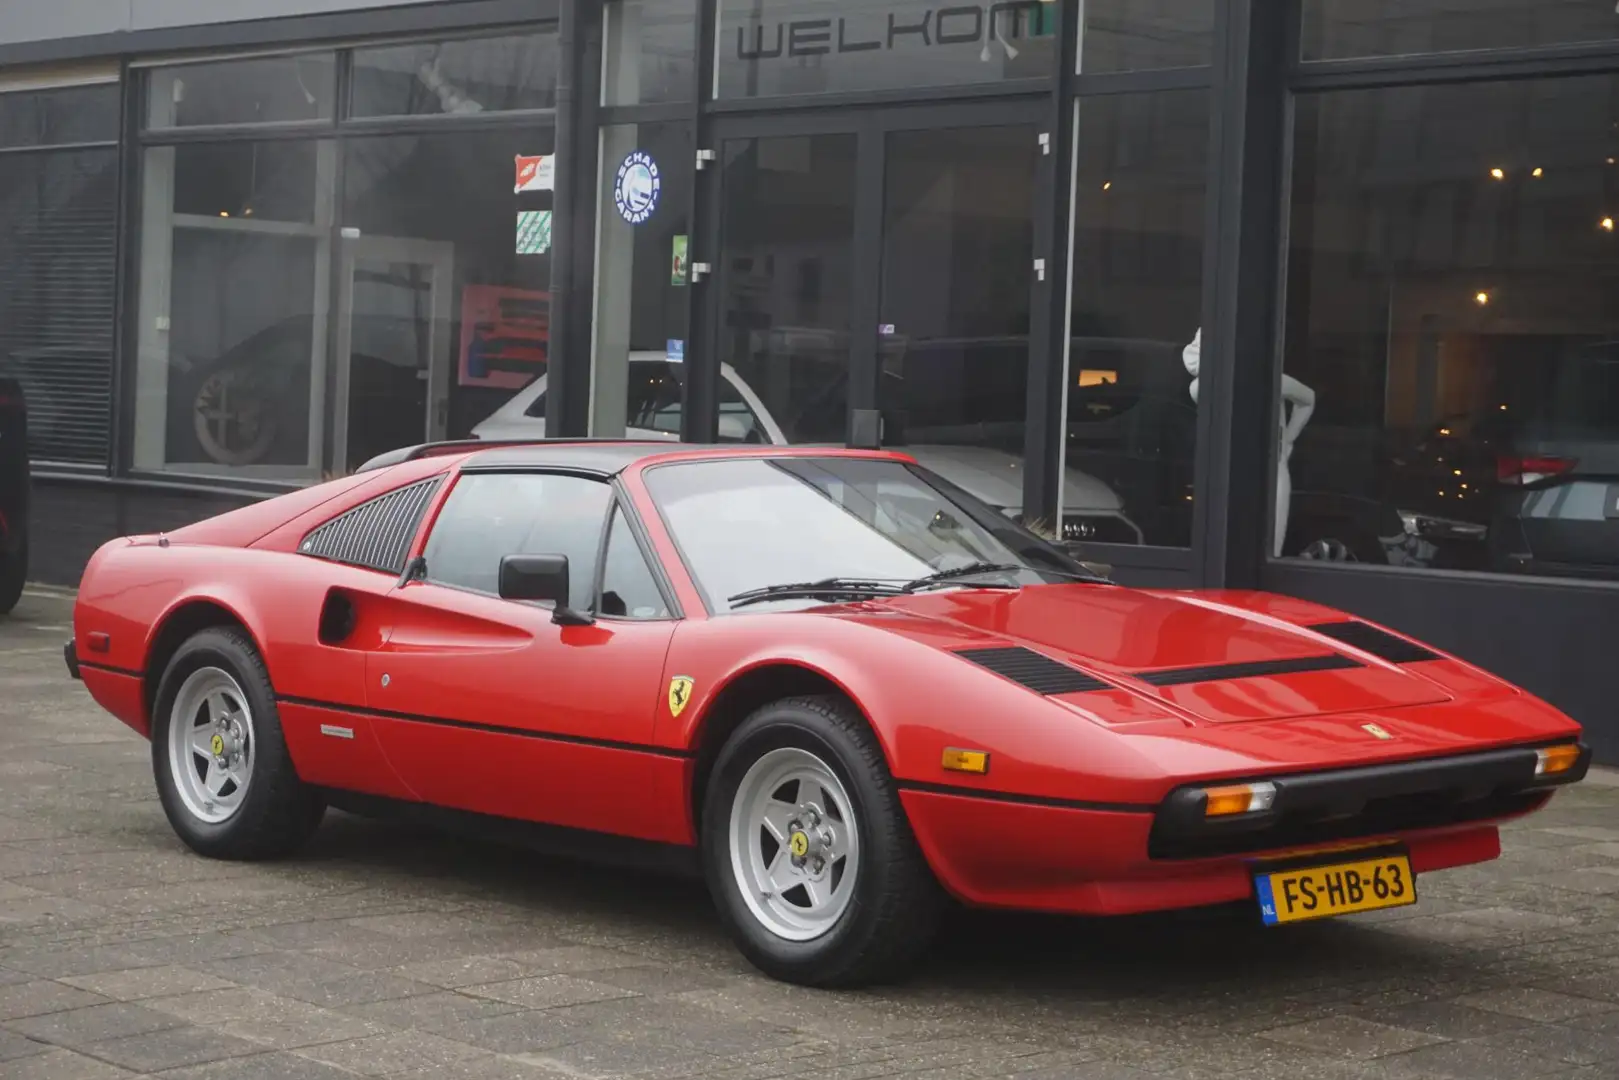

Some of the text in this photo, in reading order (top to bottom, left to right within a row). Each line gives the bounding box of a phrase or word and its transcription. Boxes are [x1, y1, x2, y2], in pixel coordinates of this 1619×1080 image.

[737, 0, 1043, 60] WELKOM
[1262, 903, 1275, 915] NL
[1282, 864, 1404, 913] FS-HB-63
